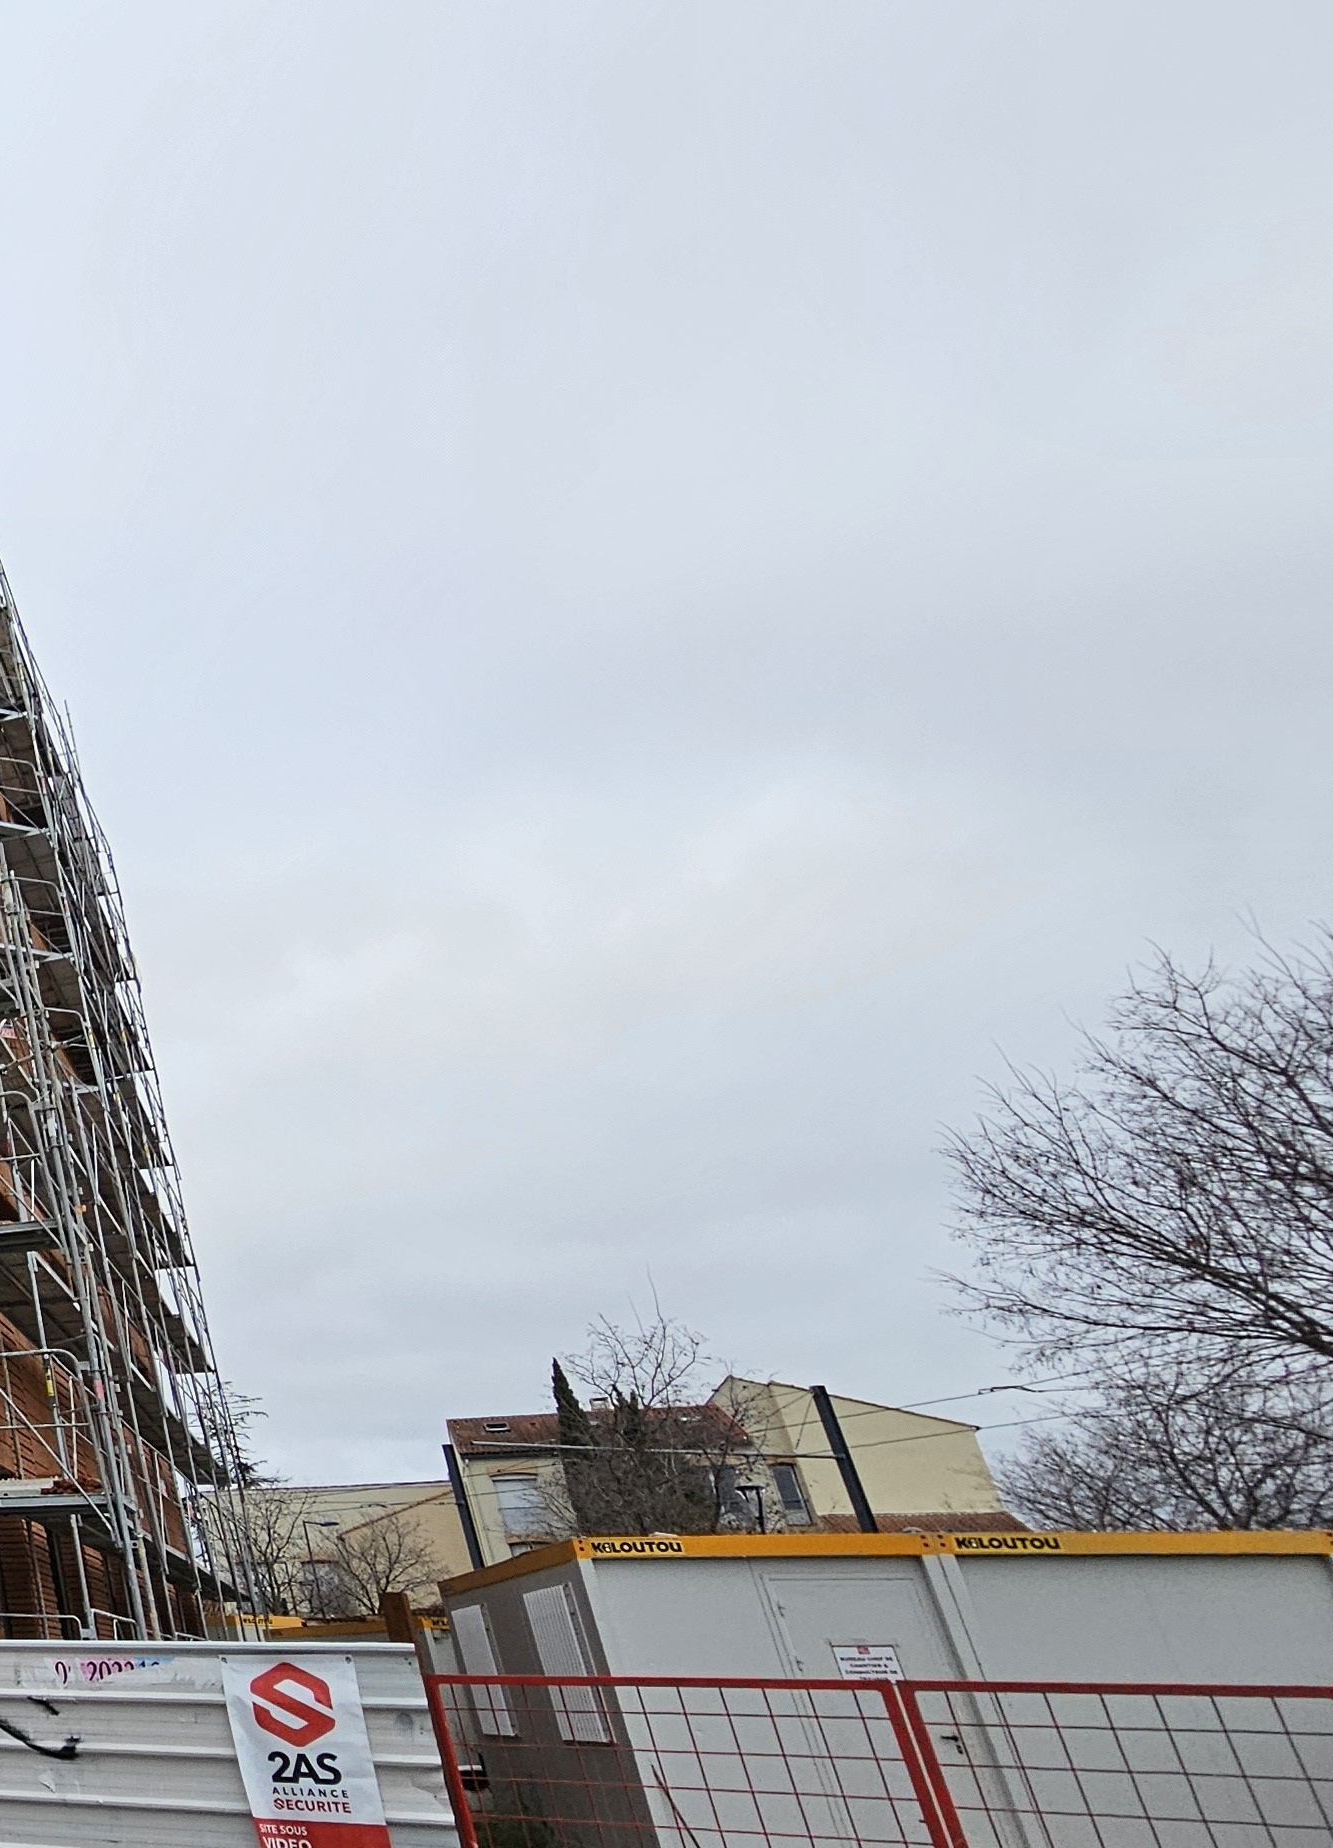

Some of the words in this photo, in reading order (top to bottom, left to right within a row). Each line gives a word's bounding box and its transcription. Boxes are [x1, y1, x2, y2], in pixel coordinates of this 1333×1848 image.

[267, 1751, 342, 1785] 2AS
[272, 1786, 349, 1799] ALLIANCE
[273, 1798, 352, 1814] SECURITE
[259, 1823, 279, 1834] SITE
[279, 1825, 308, 1836] SOUS
